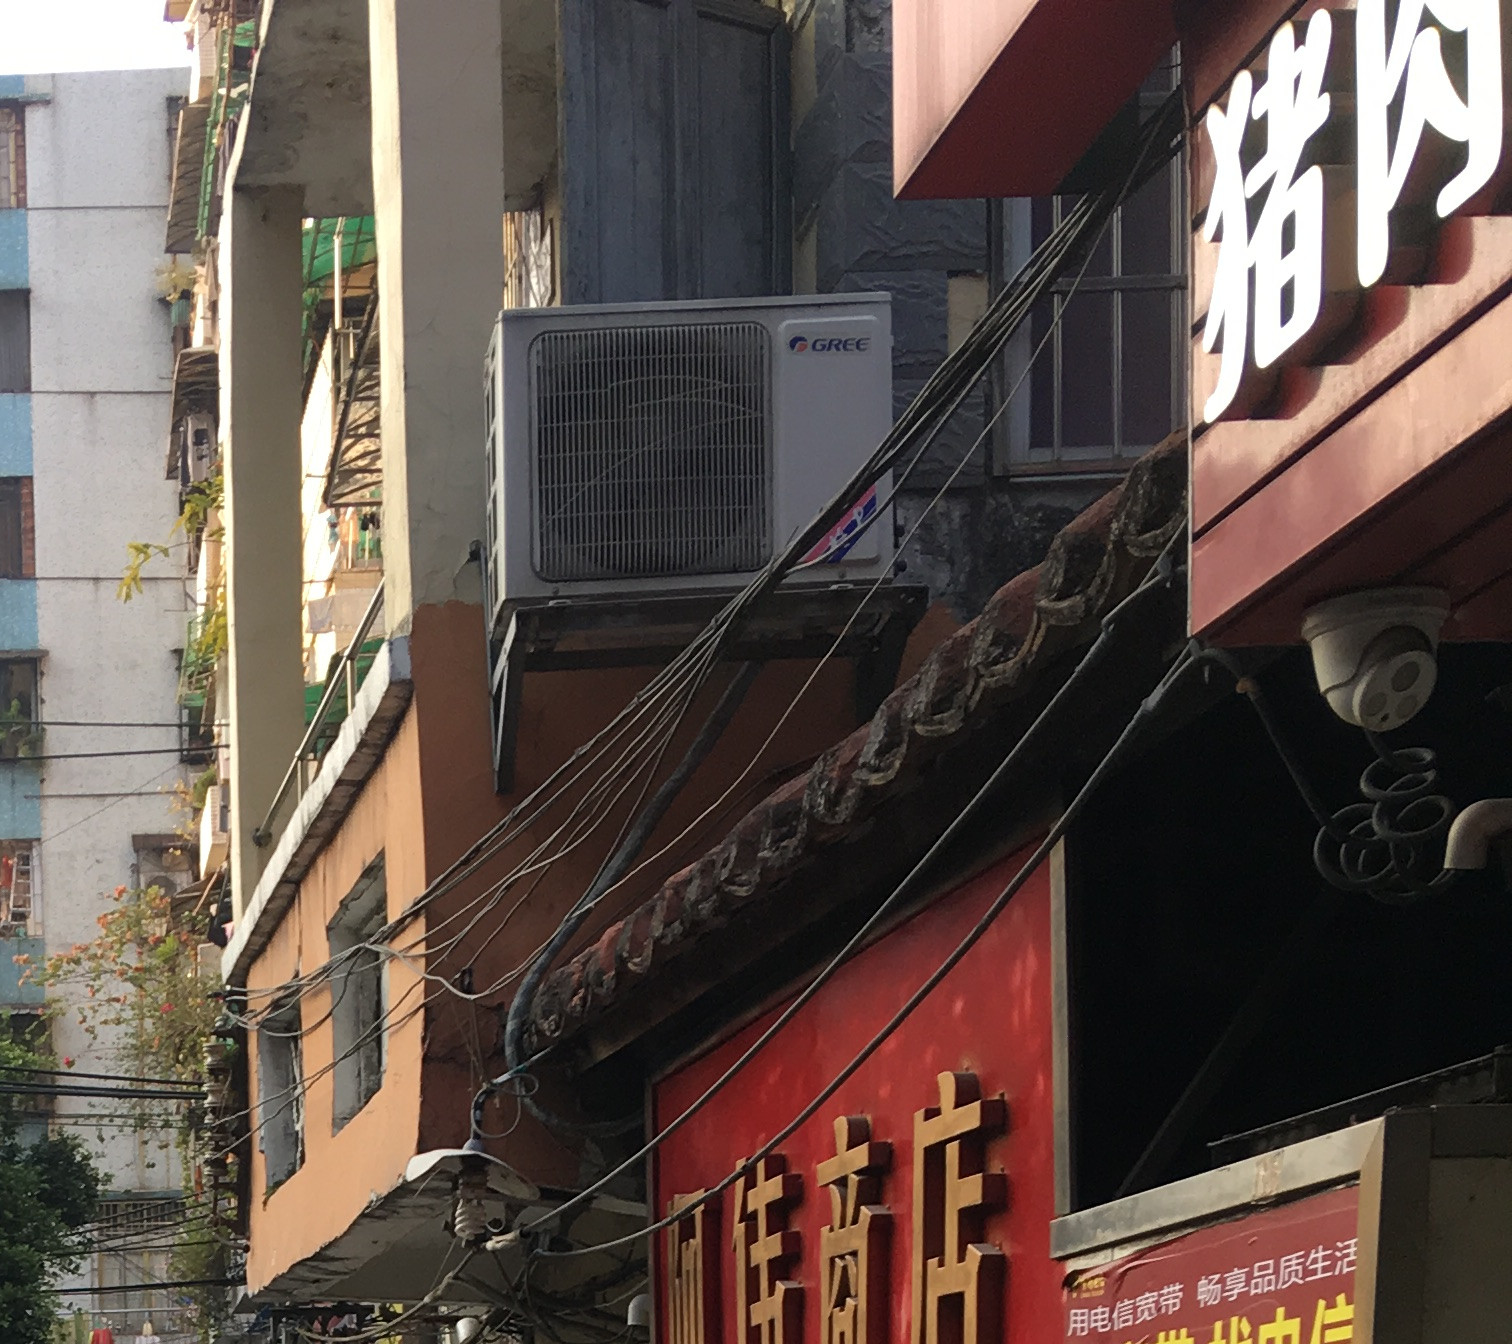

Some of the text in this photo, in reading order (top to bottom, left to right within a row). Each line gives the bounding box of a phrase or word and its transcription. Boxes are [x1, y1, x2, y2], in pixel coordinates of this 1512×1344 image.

[1202, 0, 1503, 424] 猪肉
[811, 336, 872, 352] GREE
[1067, 1238, 1359, 1338] 用电信宽带 畅享品质生活
